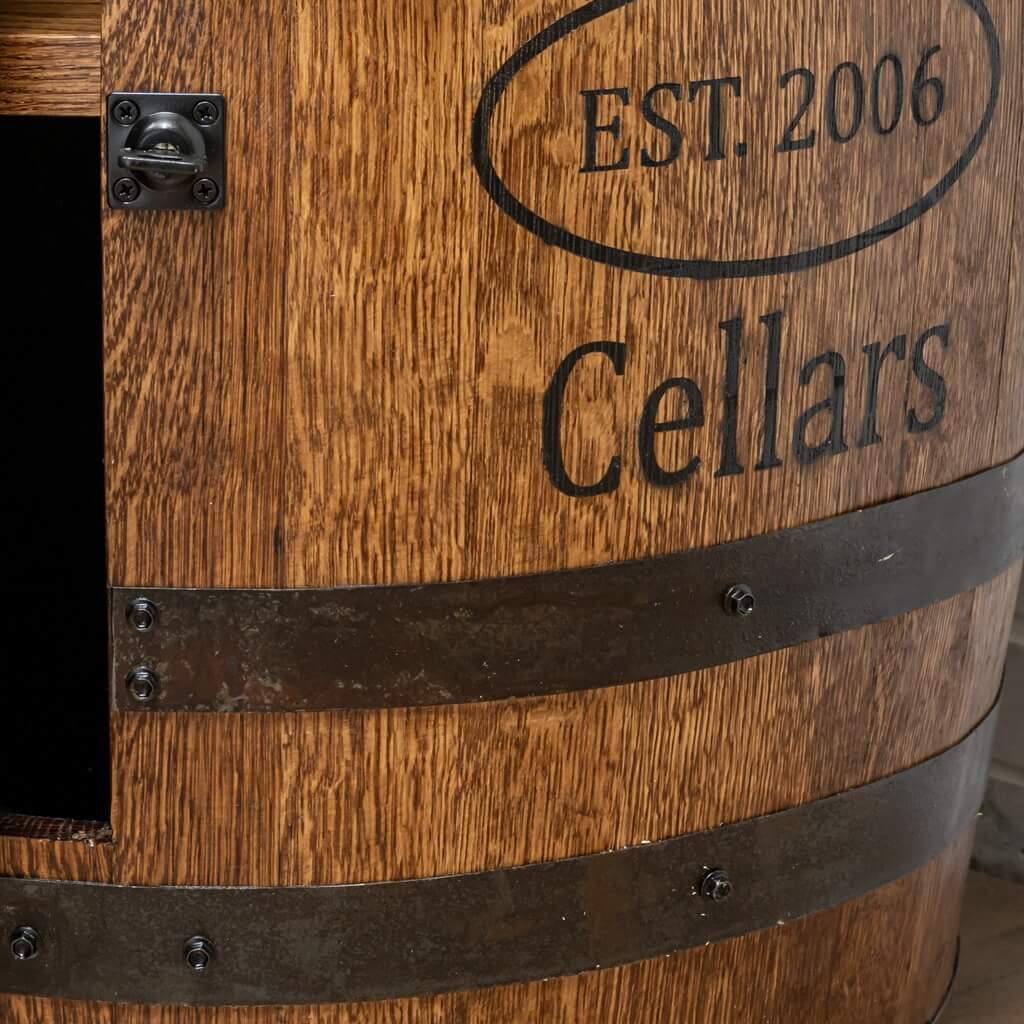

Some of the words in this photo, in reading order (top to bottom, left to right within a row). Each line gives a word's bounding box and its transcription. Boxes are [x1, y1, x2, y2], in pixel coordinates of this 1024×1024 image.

[579, 76, 747, 174] EST.
[775, 44, 946, 154] 2006
[542, 310, 952, 498] Cellars
